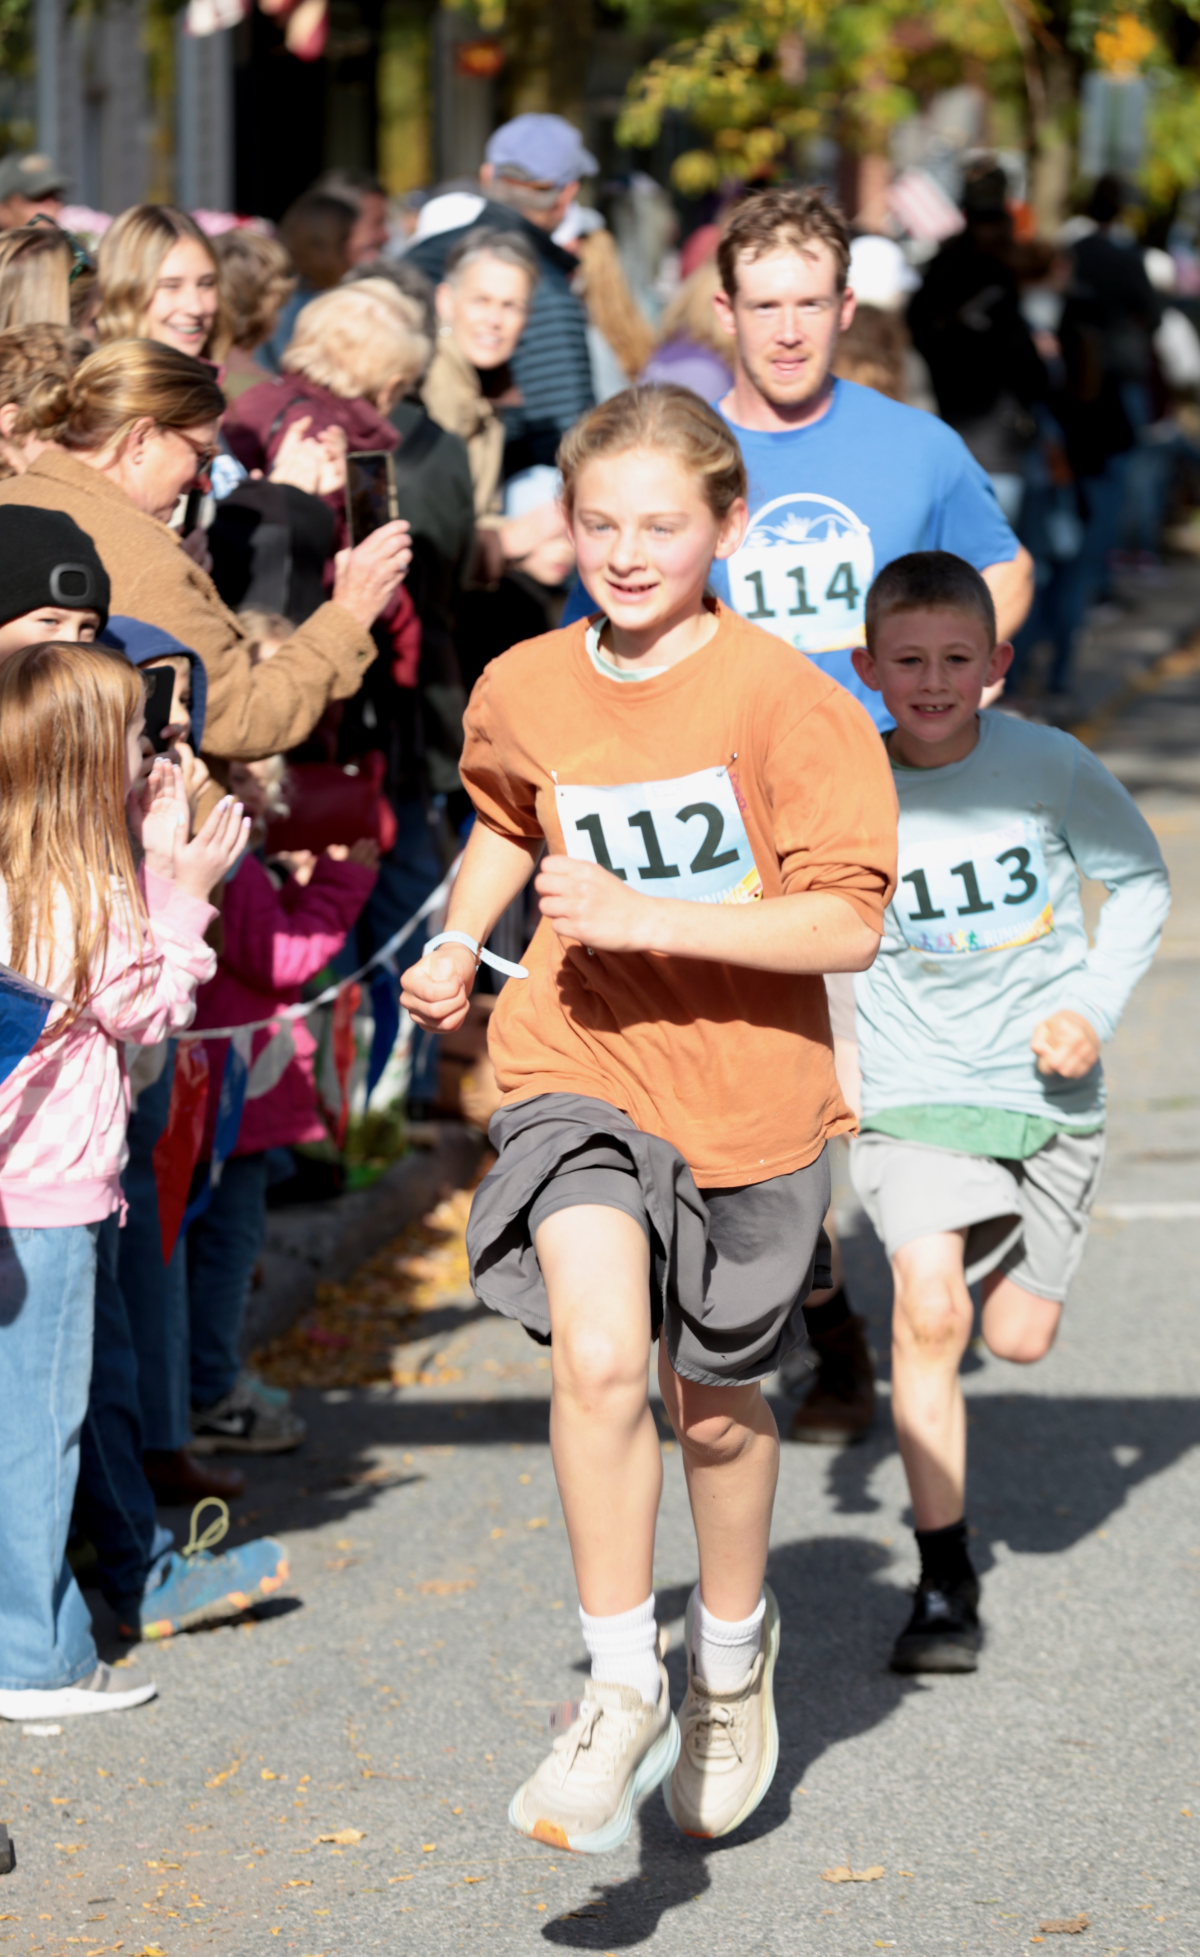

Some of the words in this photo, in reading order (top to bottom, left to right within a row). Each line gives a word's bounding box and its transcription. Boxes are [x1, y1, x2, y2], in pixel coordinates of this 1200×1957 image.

[744, 561, 861, 620] 114
[575, 801, 740, 882] 112
[901, 846, 1038, 922] 113
